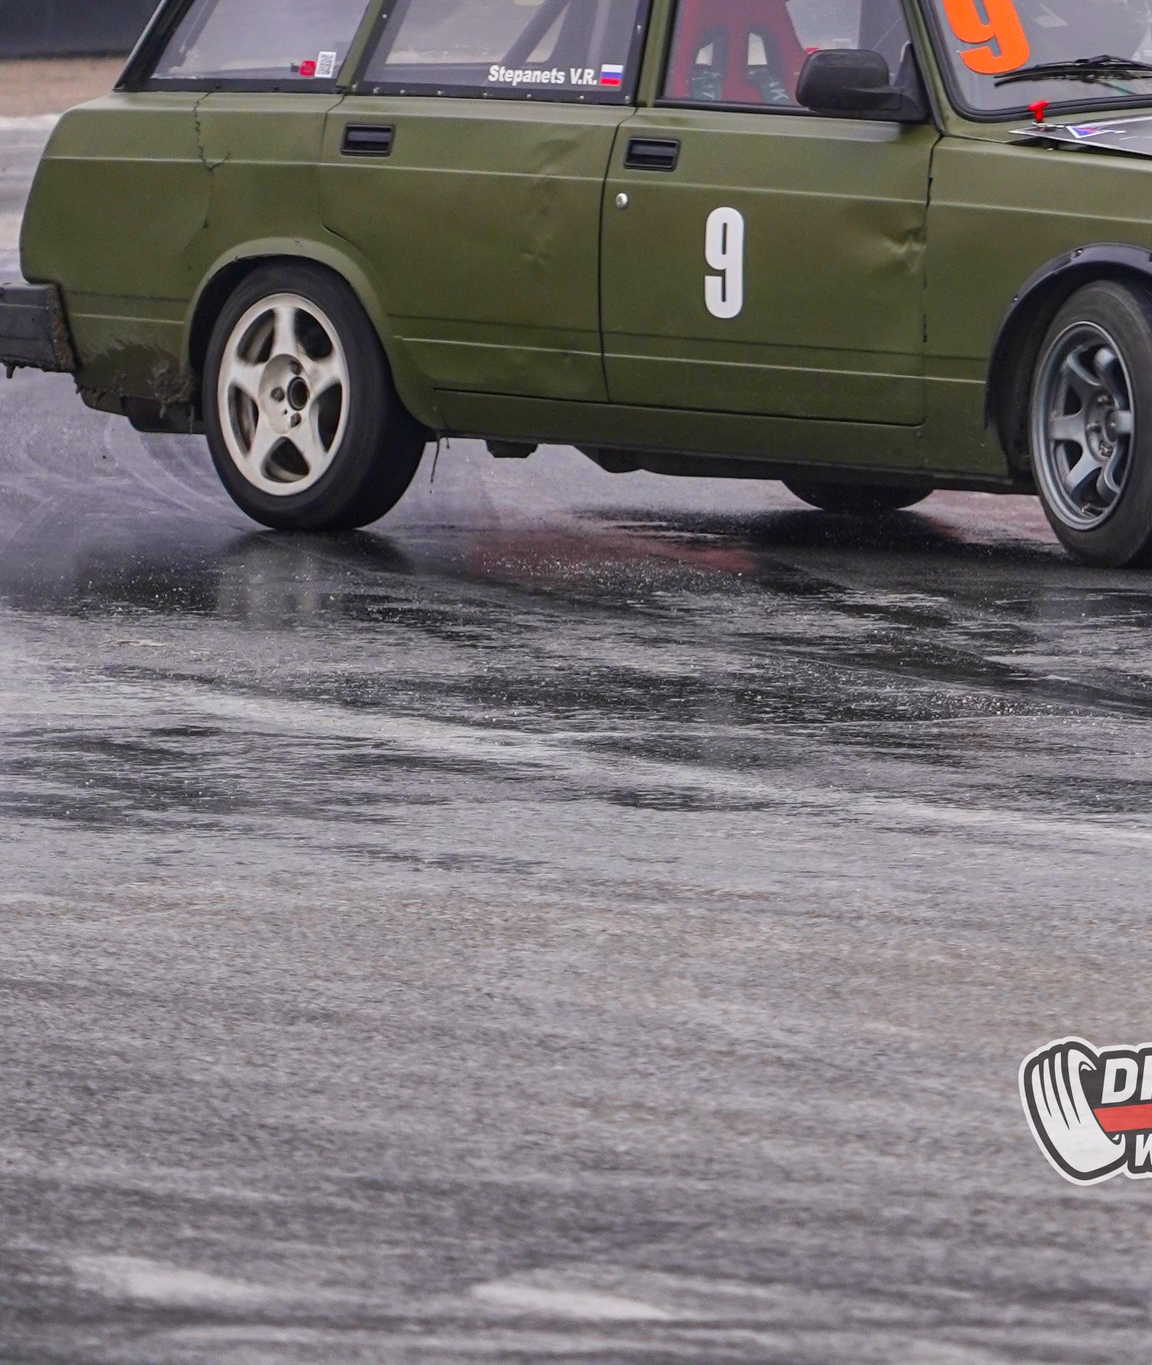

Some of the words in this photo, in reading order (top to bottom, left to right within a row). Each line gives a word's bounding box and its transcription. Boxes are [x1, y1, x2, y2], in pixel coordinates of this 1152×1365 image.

[488, 65, 566, 86] Stepanets
[569, 68, 598, 85] V.R.
[704, 206, 745, 319] 9
